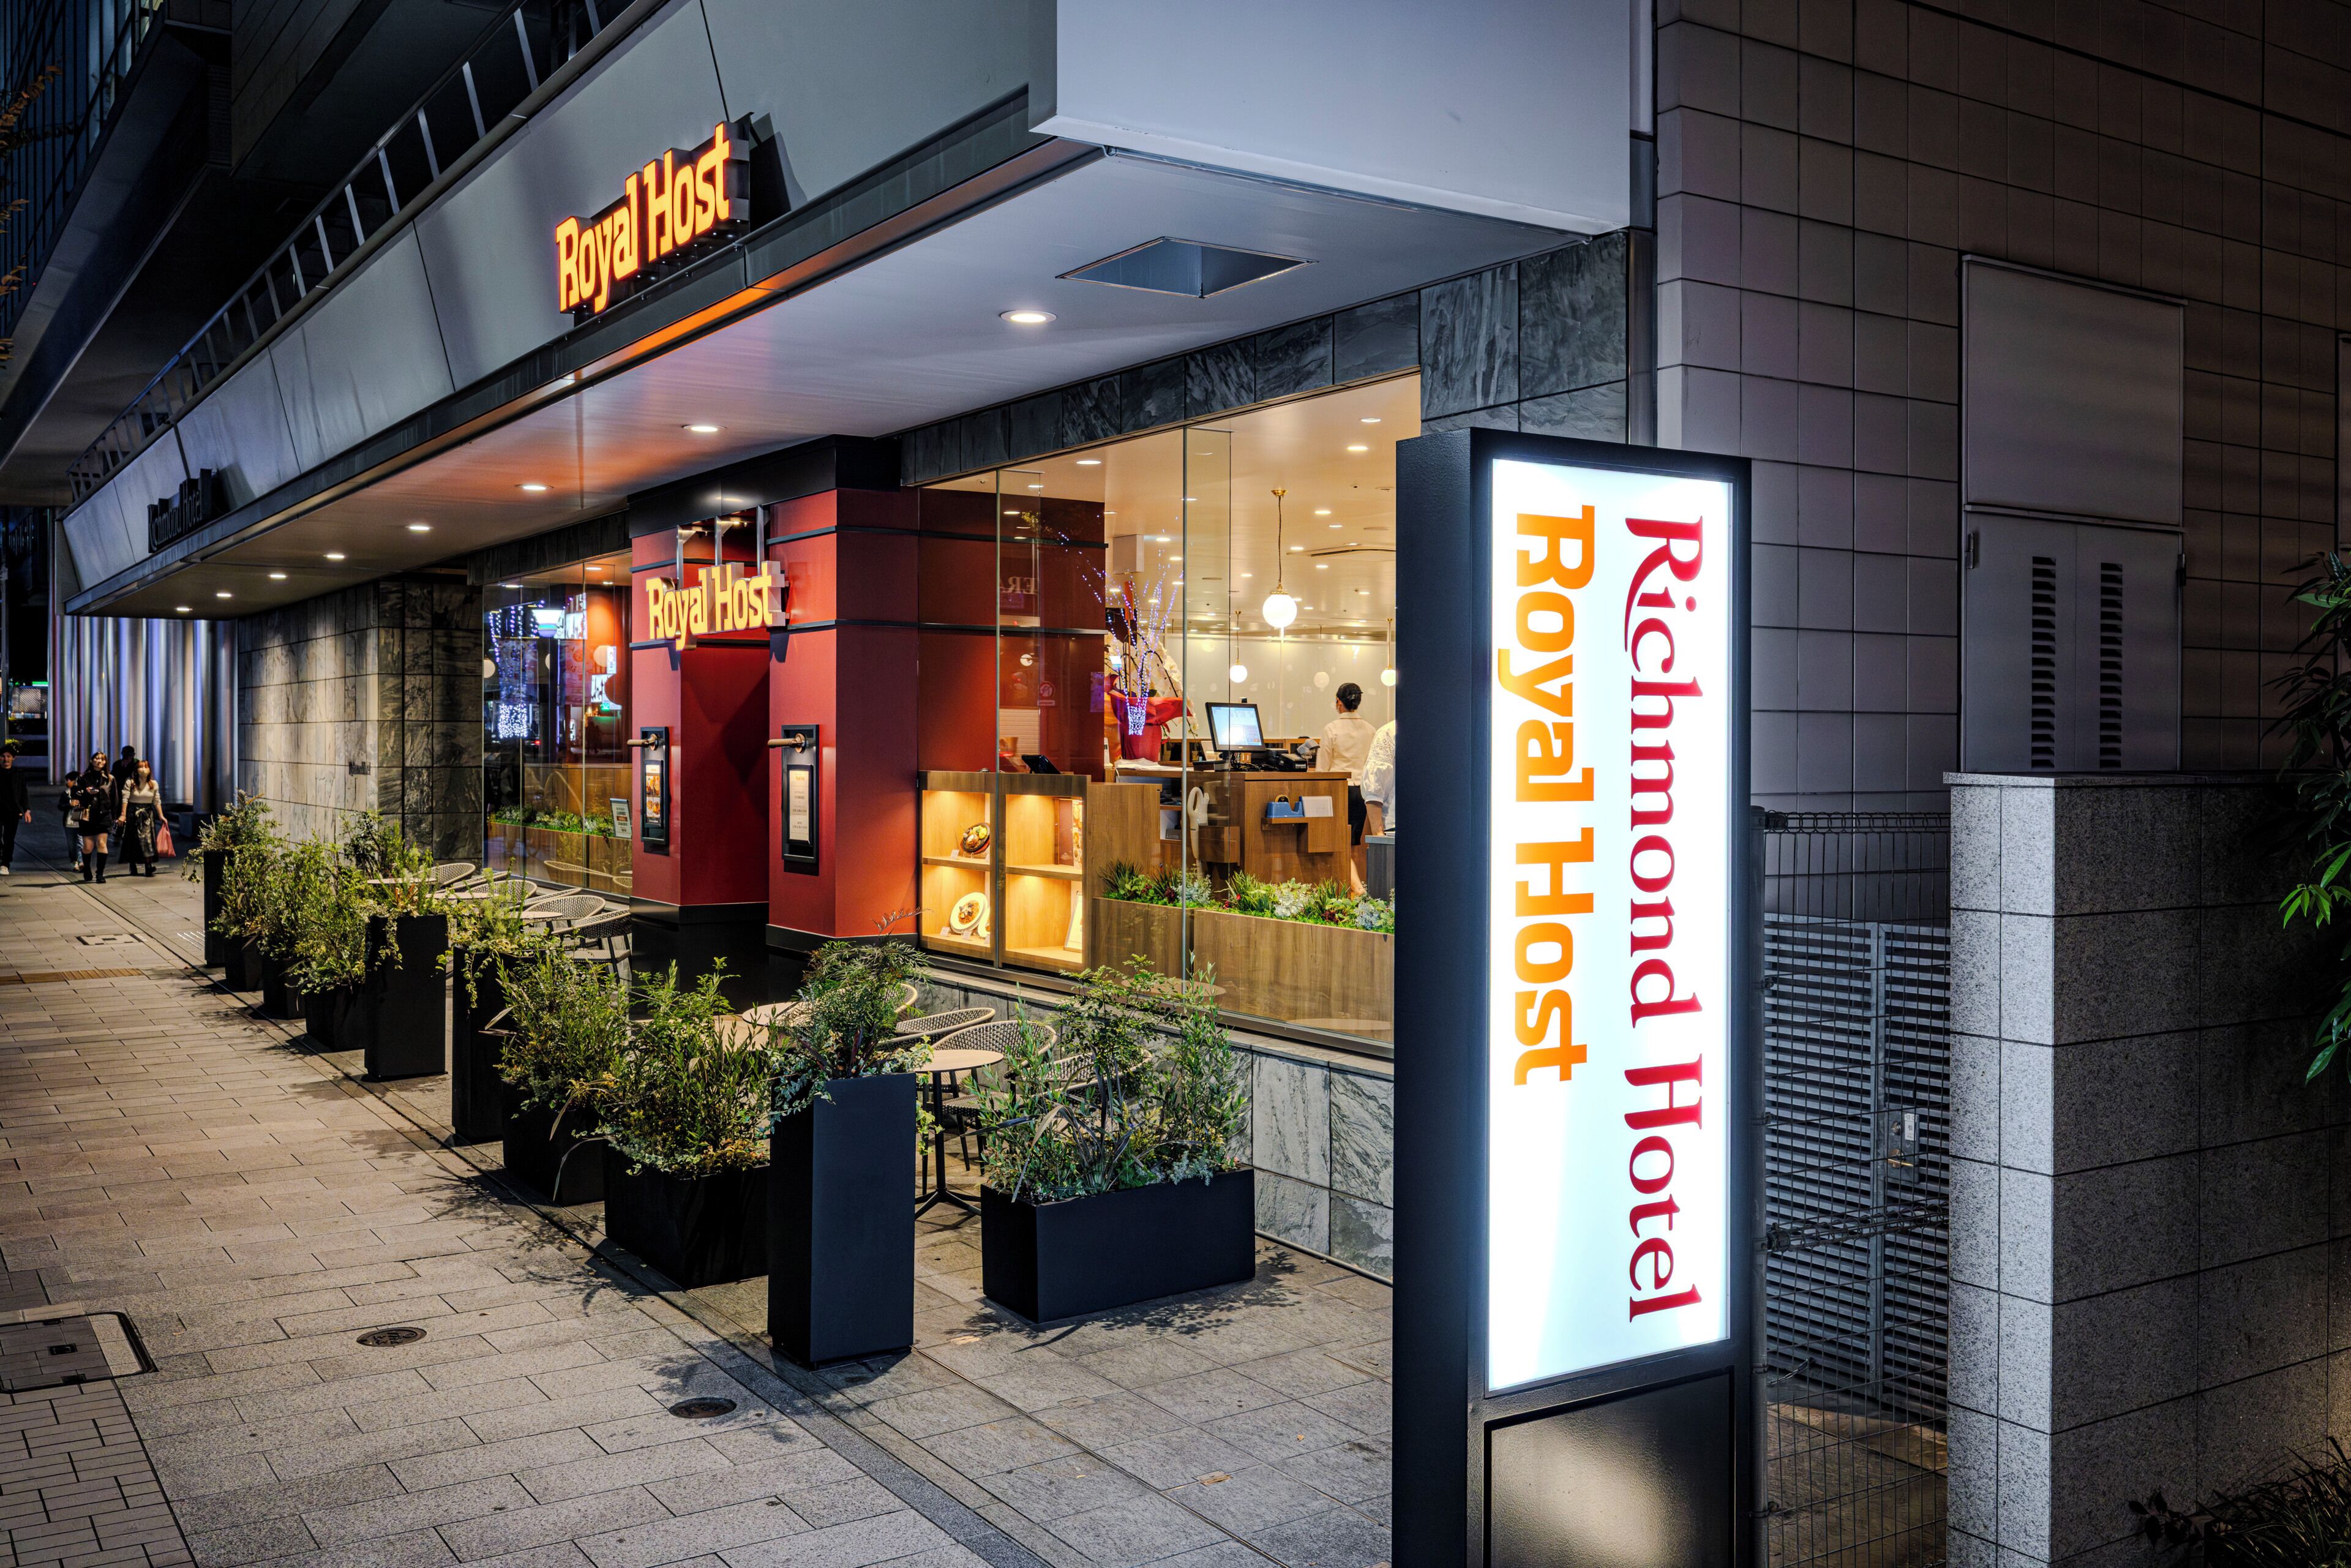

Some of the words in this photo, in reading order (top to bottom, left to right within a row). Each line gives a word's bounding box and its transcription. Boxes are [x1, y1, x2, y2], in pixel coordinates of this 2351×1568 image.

[555, 171, 639, 313] Royal
[643, 122, 731, 263] Host
[148, 482, 182, 551] Richmond
[182, 469, 203, 535] Hotel
[646, 568, 708, 650] Royal
[711, 561, 773, 631] Host
[1498, 505, 1595, 802] Royal
[1624, 516, 1704, 1029] Richmond
[1514, 827, 1594, 1086] Host
[1624, 1053, 1703, 1323] Hotel
